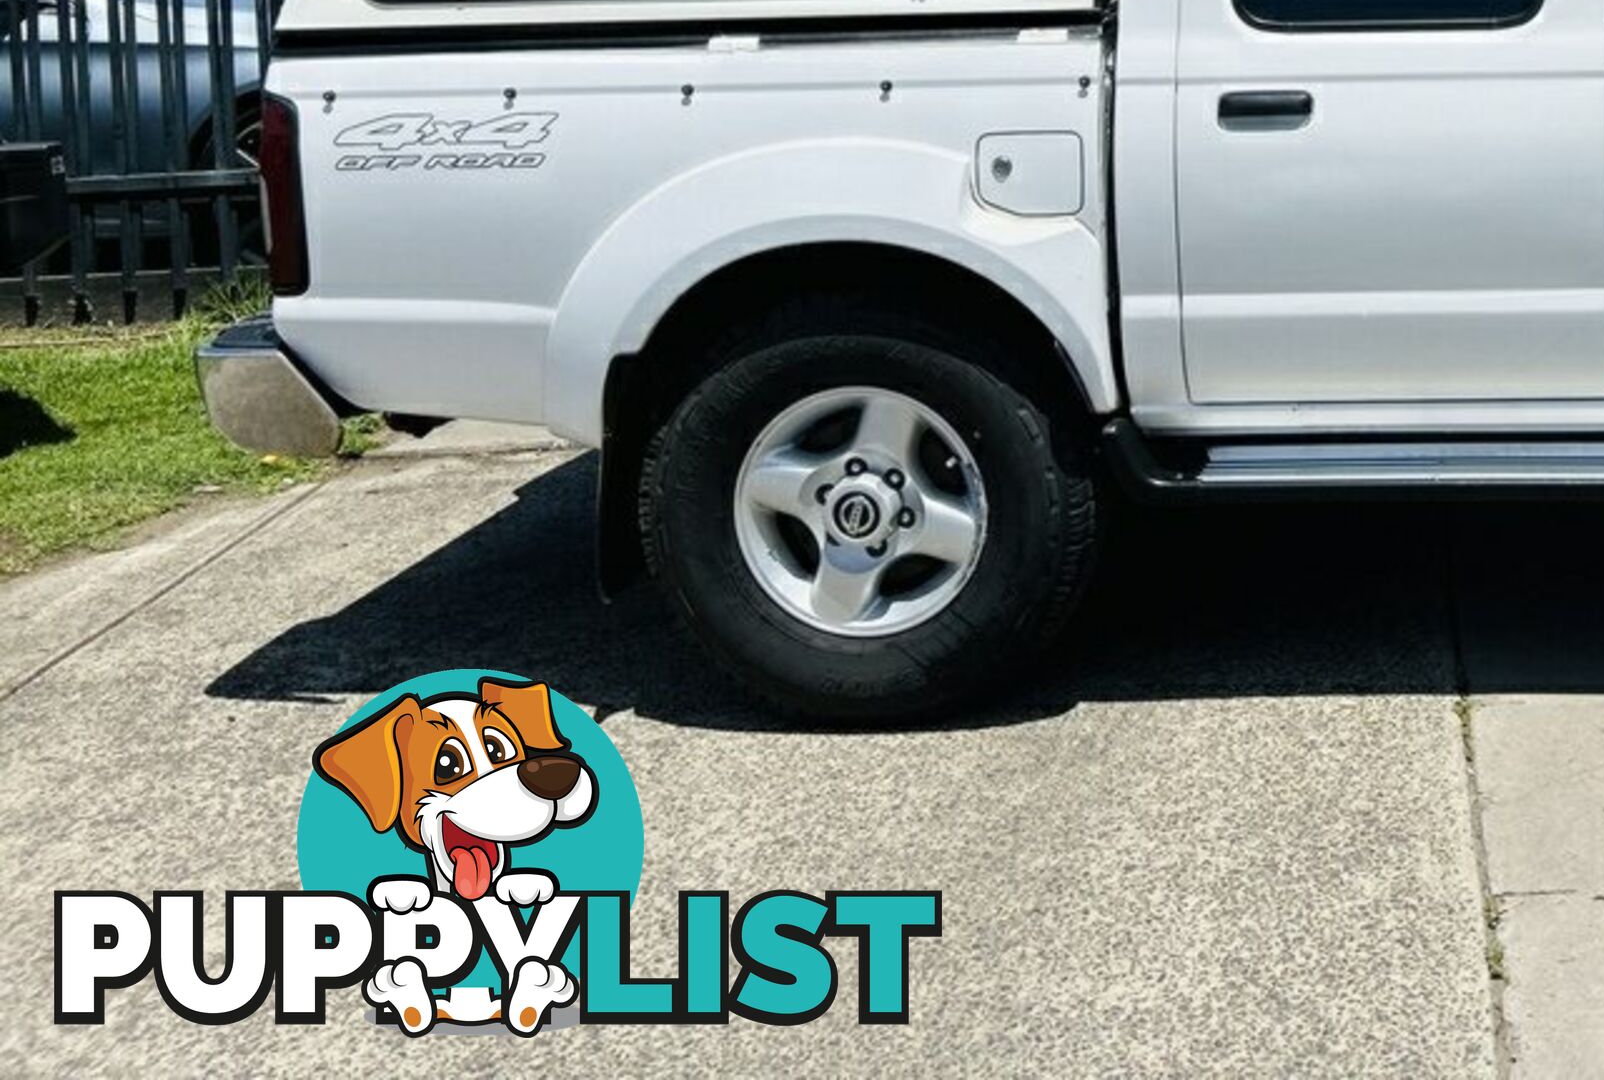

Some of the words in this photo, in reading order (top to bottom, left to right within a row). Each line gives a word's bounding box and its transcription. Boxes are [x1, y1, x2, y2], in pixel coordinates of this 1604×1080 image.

[333, 111, 560, 151] 4x4
[335, 155, 422, 170] OFF
[424, 153, 546, 169] ROAD
